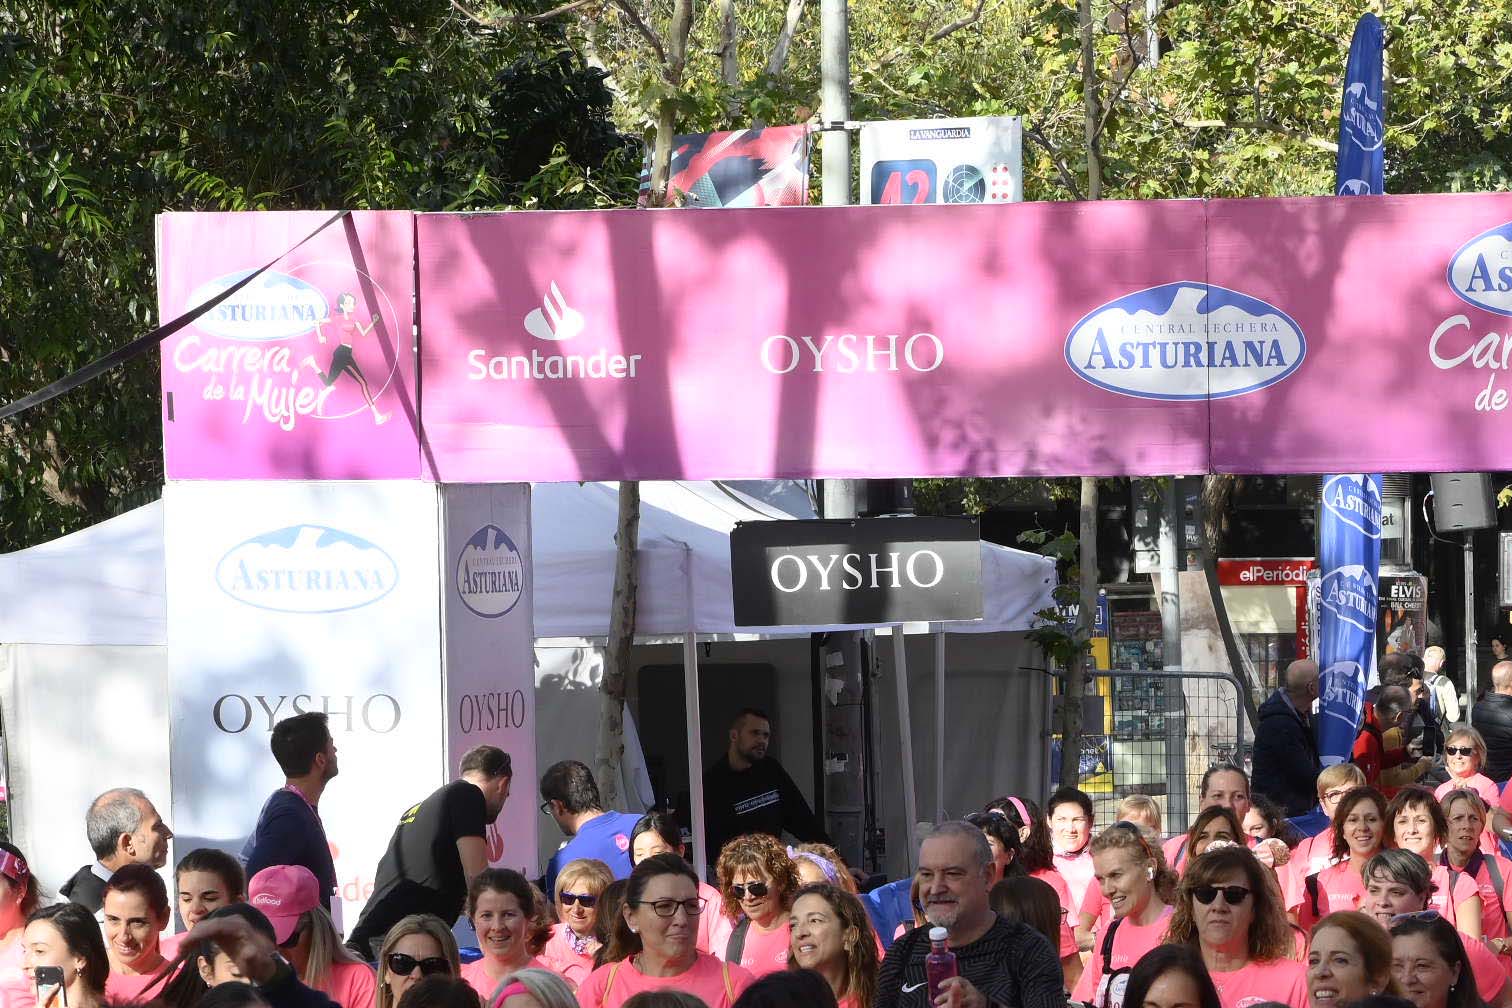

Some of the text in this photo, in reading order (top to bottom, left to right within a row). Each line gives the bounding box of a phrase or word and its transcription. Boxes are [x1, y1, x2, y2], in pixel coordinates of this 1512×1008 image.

[1083, 325, 1288, 371] ASTURIANA
[1120, 321, 1279, 336] CENTRAL LECHERA
[174, 335, 291, 373] Carrera
[468, 347, 641, 379] Santander
[760, 332, 945, 374] OYSHO
[203, 370, 337, 431] de la Mujer
[1475, 372, 1508, 412] de
[233, 559, 385, 592] ASTURIANA
[462, 566, 520, 596] ASTURIANA
[770, 550, 944, 593] OYSHO
[1391, 584, 1421, 598] ELVIS
[458, 688, 525, 735] OYSHO
